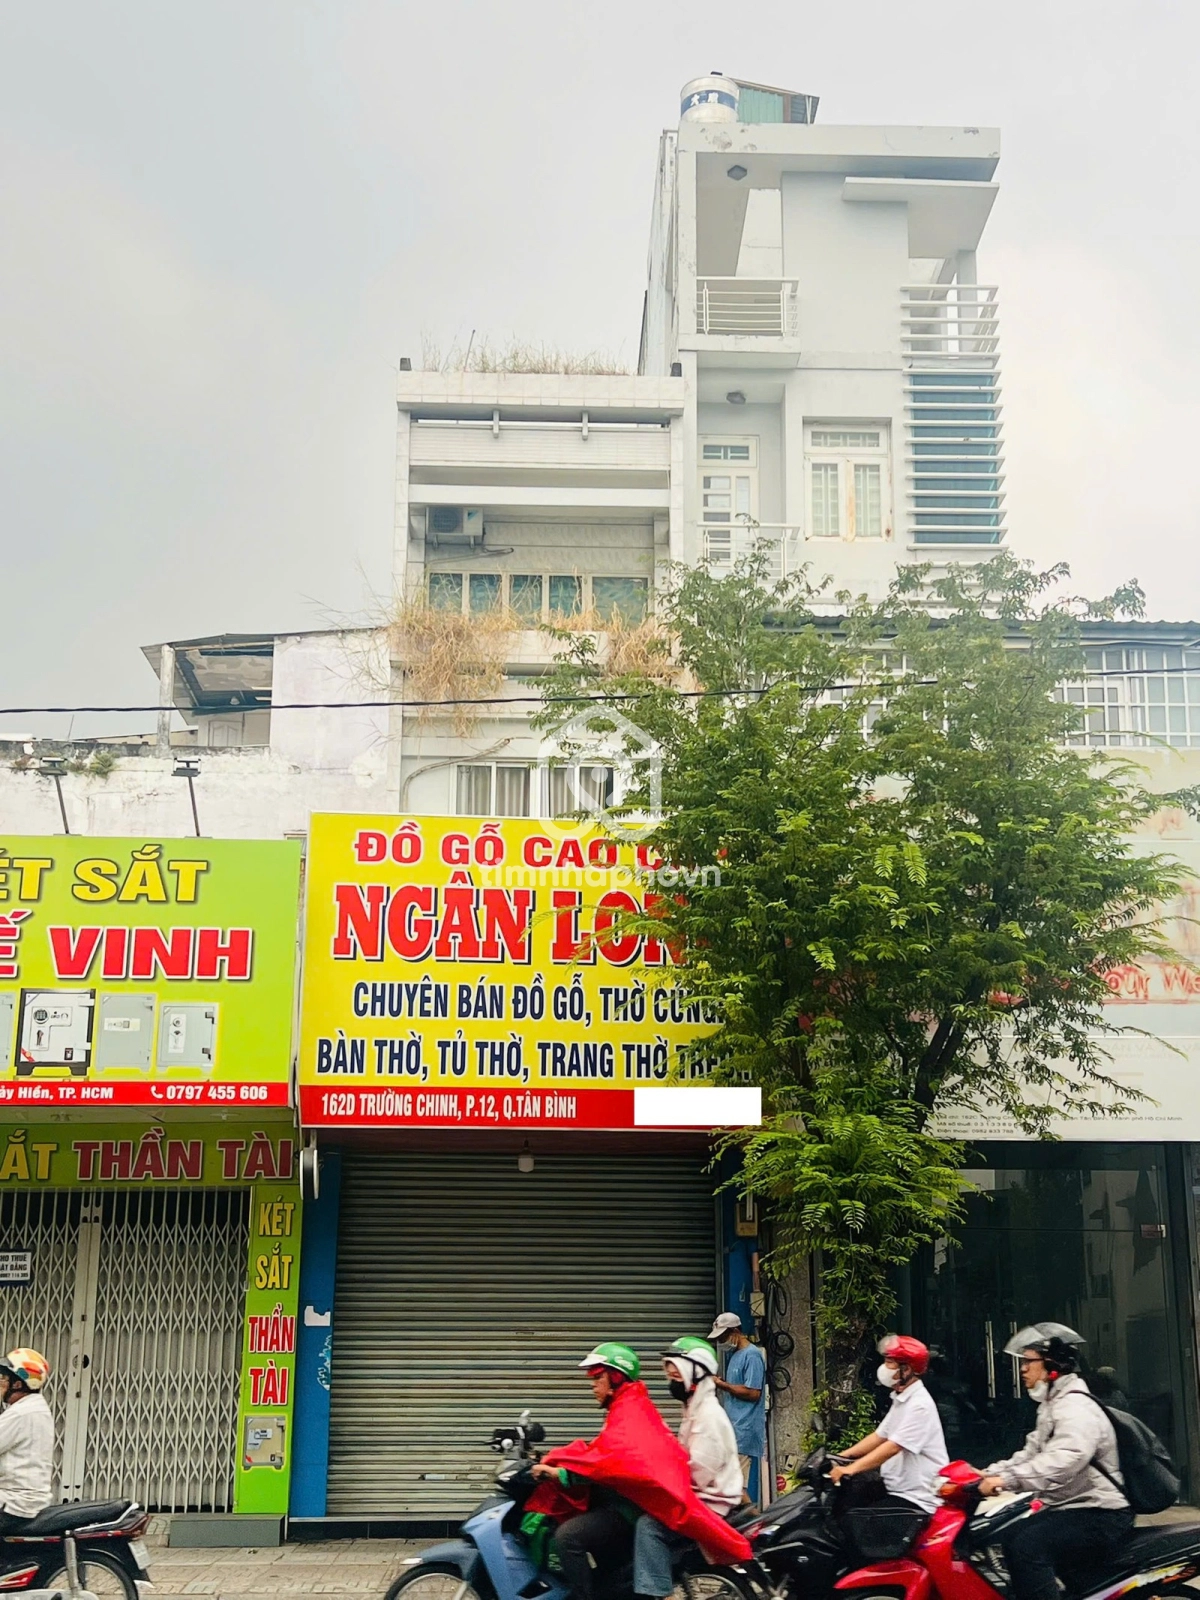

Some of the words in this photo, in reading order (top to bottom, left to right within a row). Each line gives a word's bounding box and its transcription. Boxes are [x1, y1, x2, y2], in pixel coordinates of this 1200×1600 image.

[354, 821, 423, 865] ĐỒ
[440, 822, 503, 868] GỖ
[522, 835, 620, 871] CAO
[71, 844, 209, 904] SẮT
[332, 871, 536, 965] NGÂN
[551, 889, 708, 968] LON
[47, 925, 255, 981] VINH
[353, 976, 449, 1019] CHUYÊN
[457, 976, 505, 1020] BÁN
[512, 972, 545, 1020] ĐỒ
[552, 972, 593, 1027] GỖ,
[599, 979, 646, 1023] THỜ
[317, 1028, 365, 1076] BÀN
[373, 1030, 429, 1083] THỜ,
[437, 1029, 467, 1077] TỦ
[475, 1031, 530, 1084] THỜ,
[537, 1040, 614, 1080] TRANG
[622, 1035, 669, 1080] THỜ
[58, 1086, 77, 1099] TP.
[81, 1086, 114, 1099] HCM
[166, 1085, 203, 1100] 0797
[207, 1085, 236, 1100] 455
[239, 1085, 269, 1100] 606
[321, 1092, 356, 1116] 162D
[359, 1088, 412, 1117] TRƯỜNG
[416, 1093, 462, 1121] CHINH,
[465, 1094, 499, 1121] P.12,
[503, 1090, 541, 1119] Q.TÂN
[545, 1091, 577, 1119] BÌNH
[73, 1128, 202, 1181] THẦN
[217, 1131, 294, 1181] TÀI
[258, 1195, 295, 1238] KÉT
[254, 1242, 293, 1290] SẮT
[248, 1303, 296, 1355] THẦN
[249, 1358, 289, 1406] TÀI
